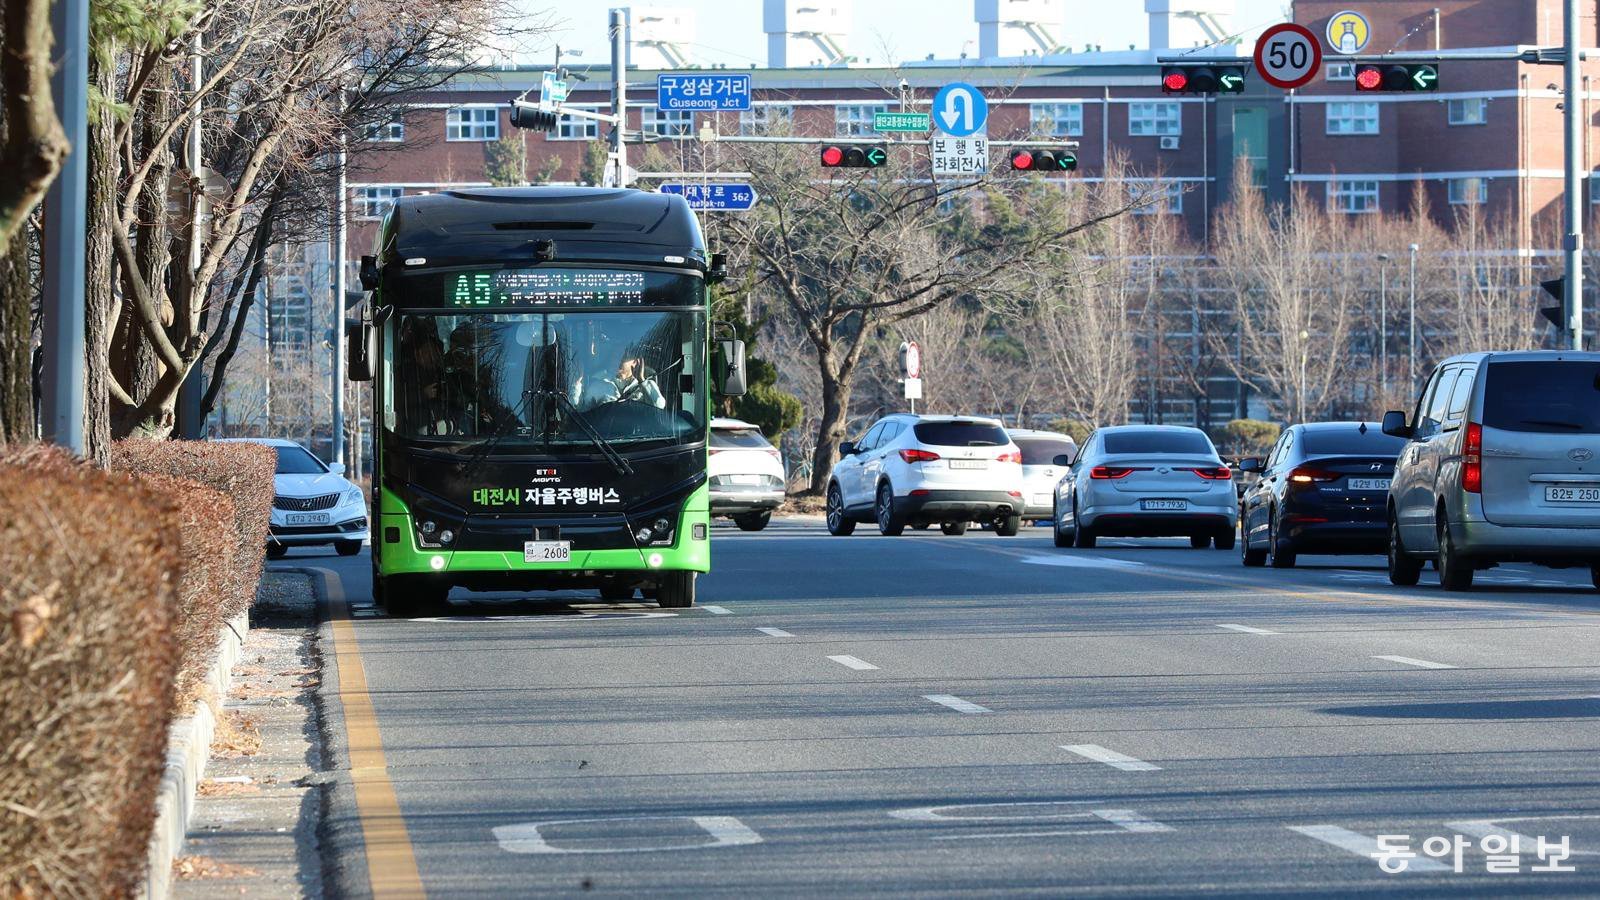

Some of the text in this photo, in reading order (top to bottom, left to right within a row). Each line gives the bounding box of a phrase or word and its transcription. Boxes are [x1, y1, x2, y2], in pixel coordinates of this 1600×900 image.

[1269, 42, 1308, 69] 50
[661, 77, 748, 96] 구성삼거리
[669, 98, 740, 110] Guseong Jct
[935, 157, 987, 172] 좌회전시
[732, 192, 750, 202] 362
[455, 274, 491, 305] A5
[473, 487, 621, 506] 대전시 자율주행버스
[544, 547, 568, 559] 2608
